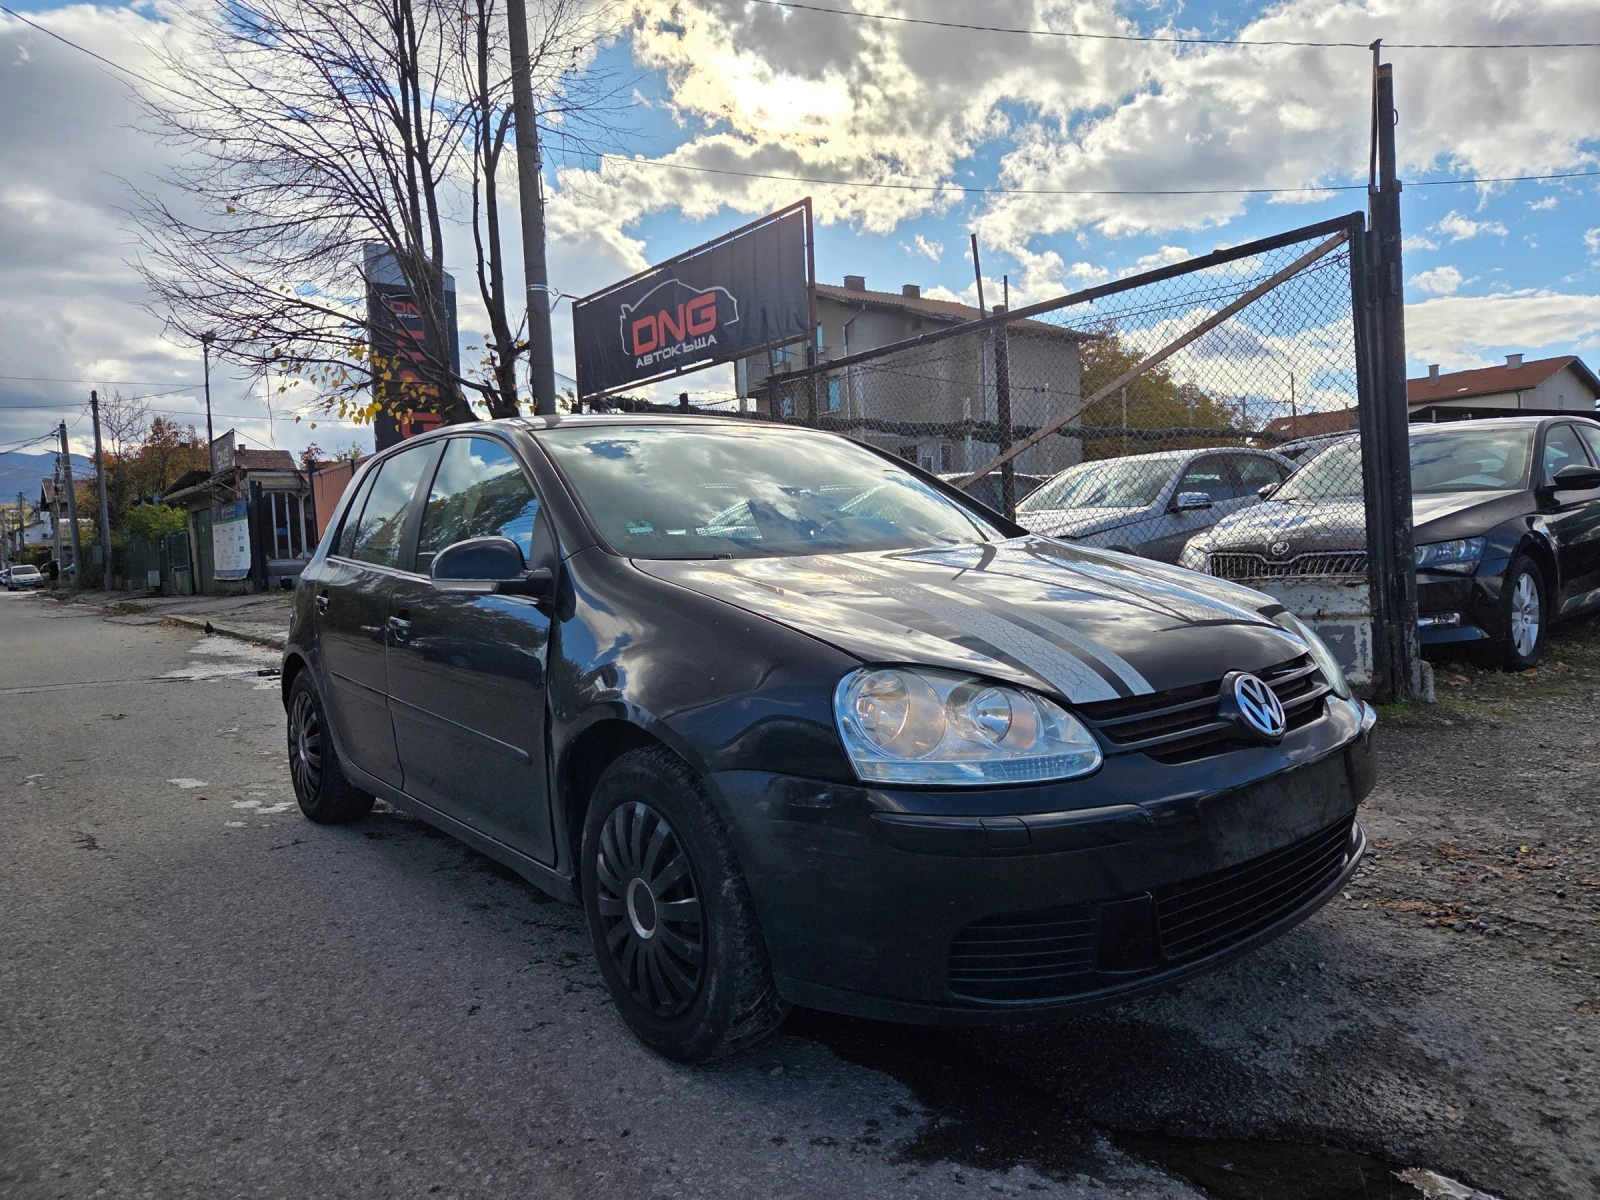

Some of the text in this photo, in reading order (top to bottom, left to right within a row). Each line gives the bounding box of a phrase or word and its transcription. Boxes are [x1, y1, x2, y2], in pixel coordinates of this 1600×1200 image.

[389, 300, 421, 315] DN
[632, 291, 717, 356] DNG
[635, 334, 718, 369] АВТОКЪША
